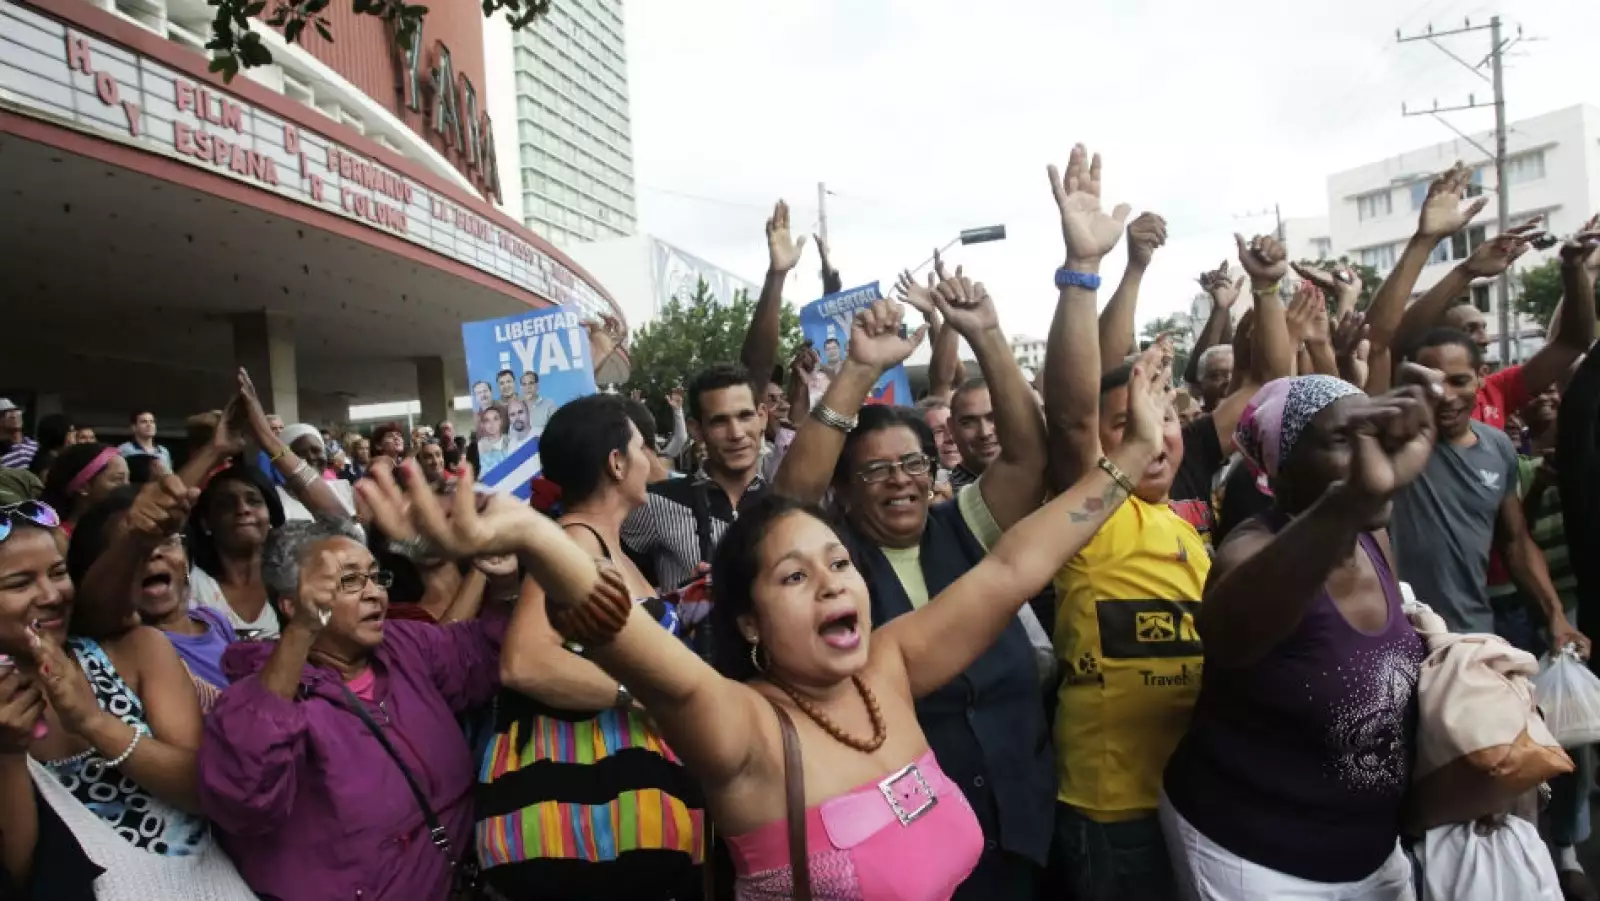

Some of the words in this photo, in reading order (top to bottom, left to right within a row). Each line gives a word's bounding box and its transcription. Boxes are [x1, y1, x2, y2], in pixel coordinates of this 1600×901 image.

[66, 28, 141, 137] HOY
[175, 79, 244, 134] FILM
[328, 149, 413, 205] FERNANDO
[495, 311, 578, 343] LIBERTAD
[500, 329, 584, 375] ¡YA!
